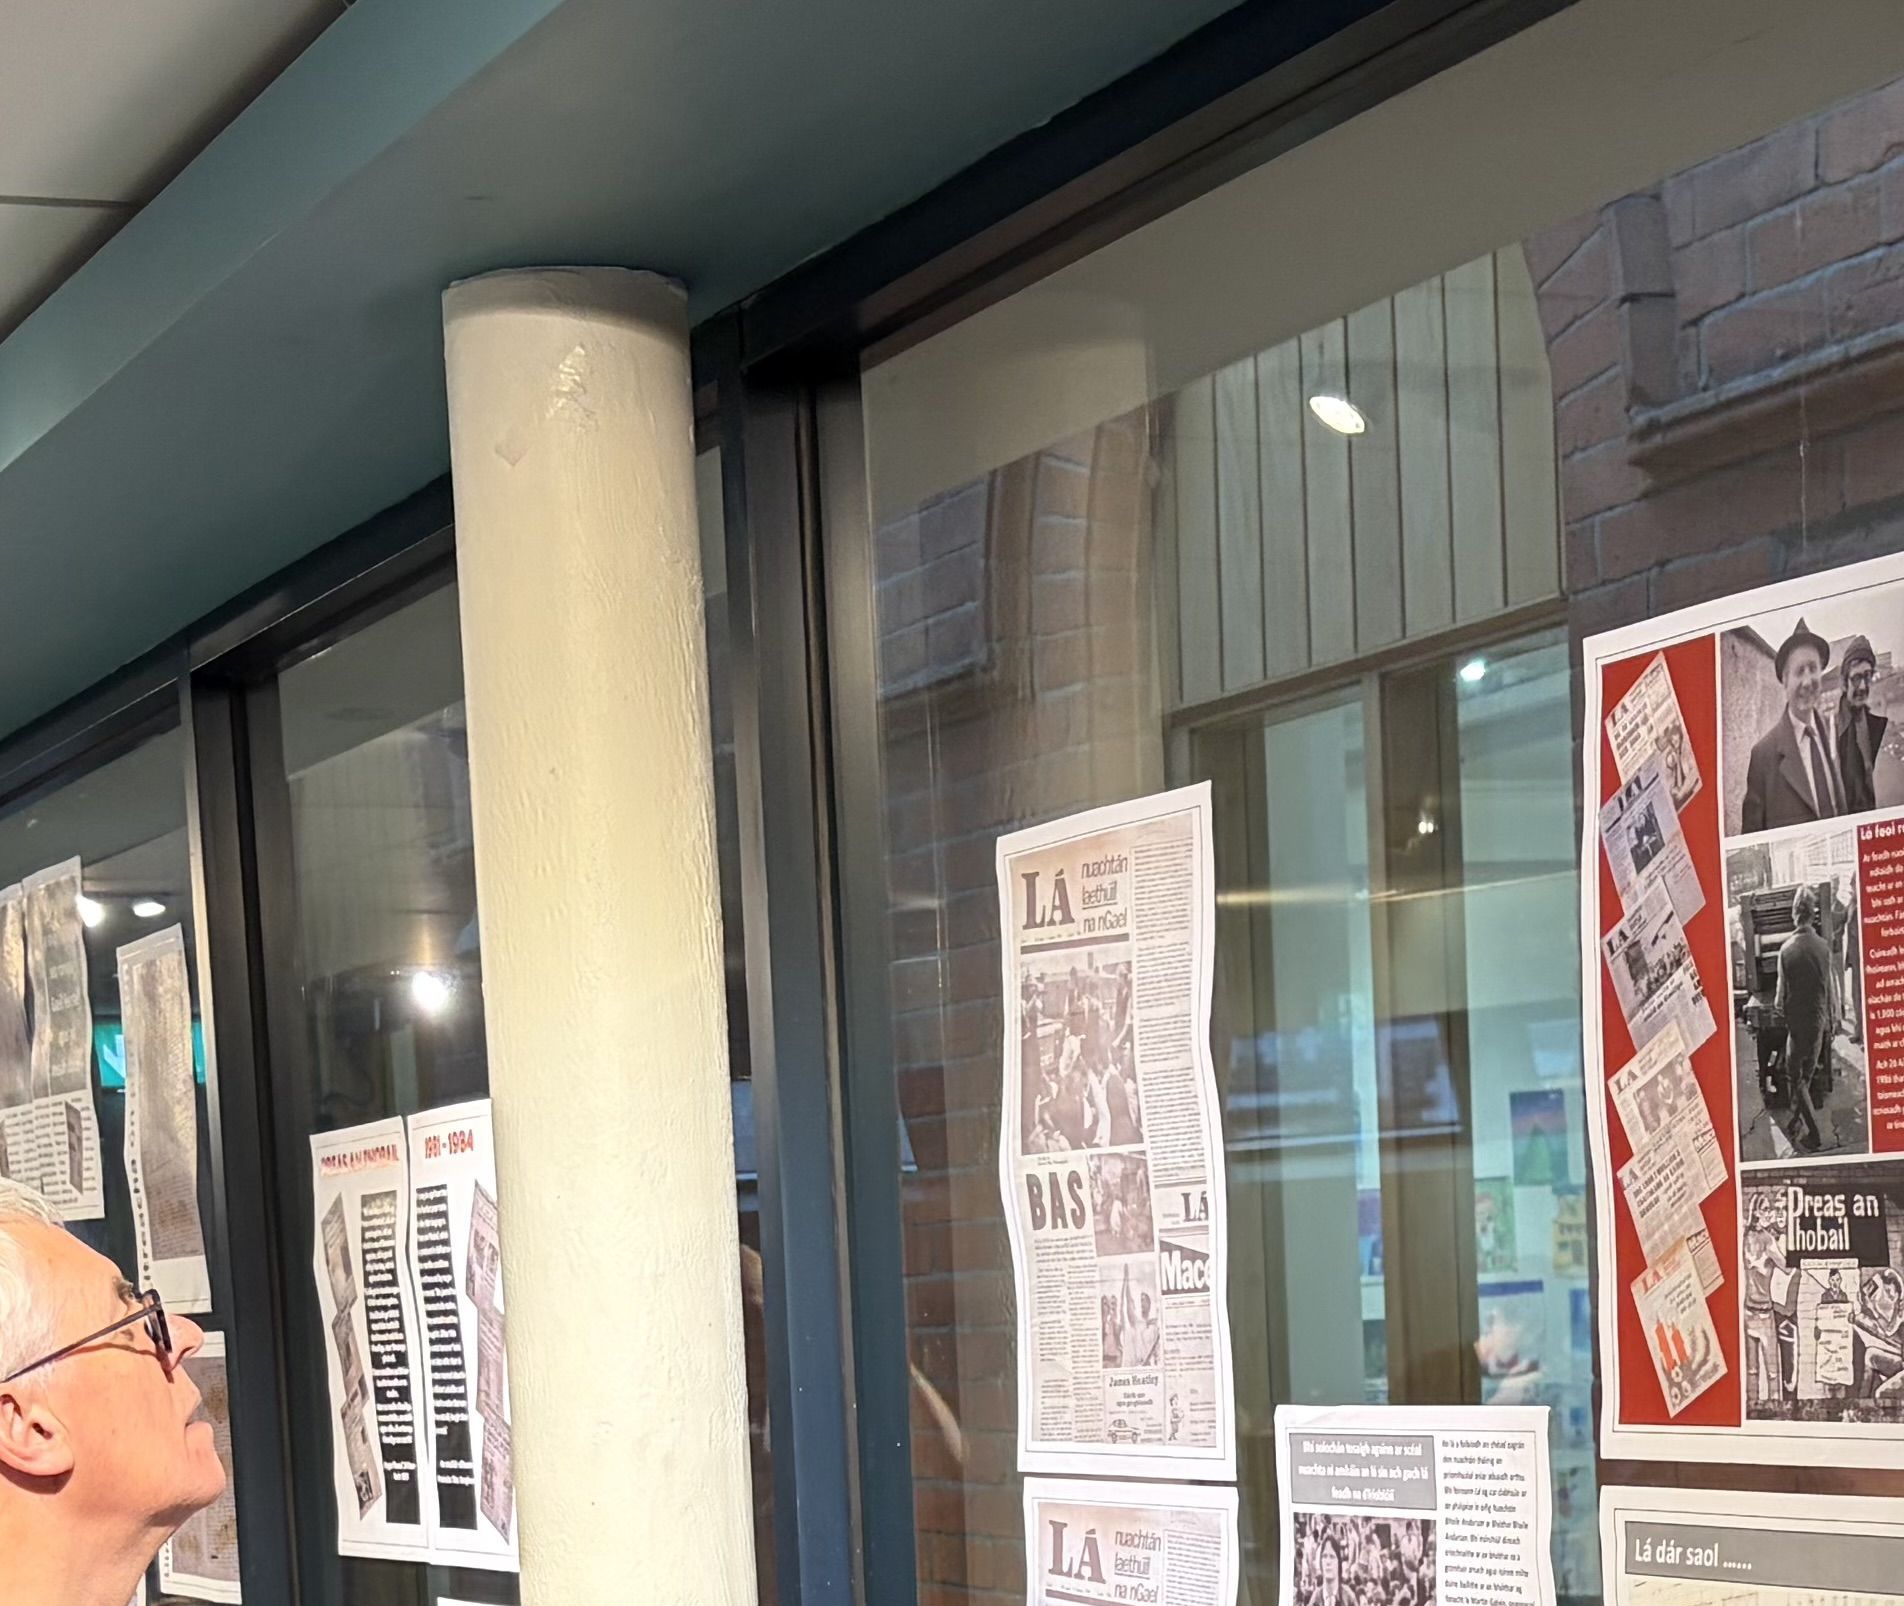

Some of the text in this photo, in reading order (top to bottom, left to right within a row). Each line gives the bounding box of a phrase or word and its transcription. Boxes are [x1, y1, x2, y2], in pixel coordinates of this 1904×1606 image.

[1861, 826, 1873, 840] Lá
[1875, 824, 1895, 837] faoi
[1082, 854, 1128, 879] nuachtán
[1021, 868, 1075, 930] LÁ
[1025, 1170, 1086, 1232] BAS
[1788, 1187, 1880, 1218] Preas an
[1047, 1519, 1106, 1584] LÁ
[1114, 1528, 1162, 1554] nuachtán
[1634, 1537, 1652, 1562] Lá
[1655, 1538, 1683, 1564] dár
[1685, 1542, 1718, 1567] saol
